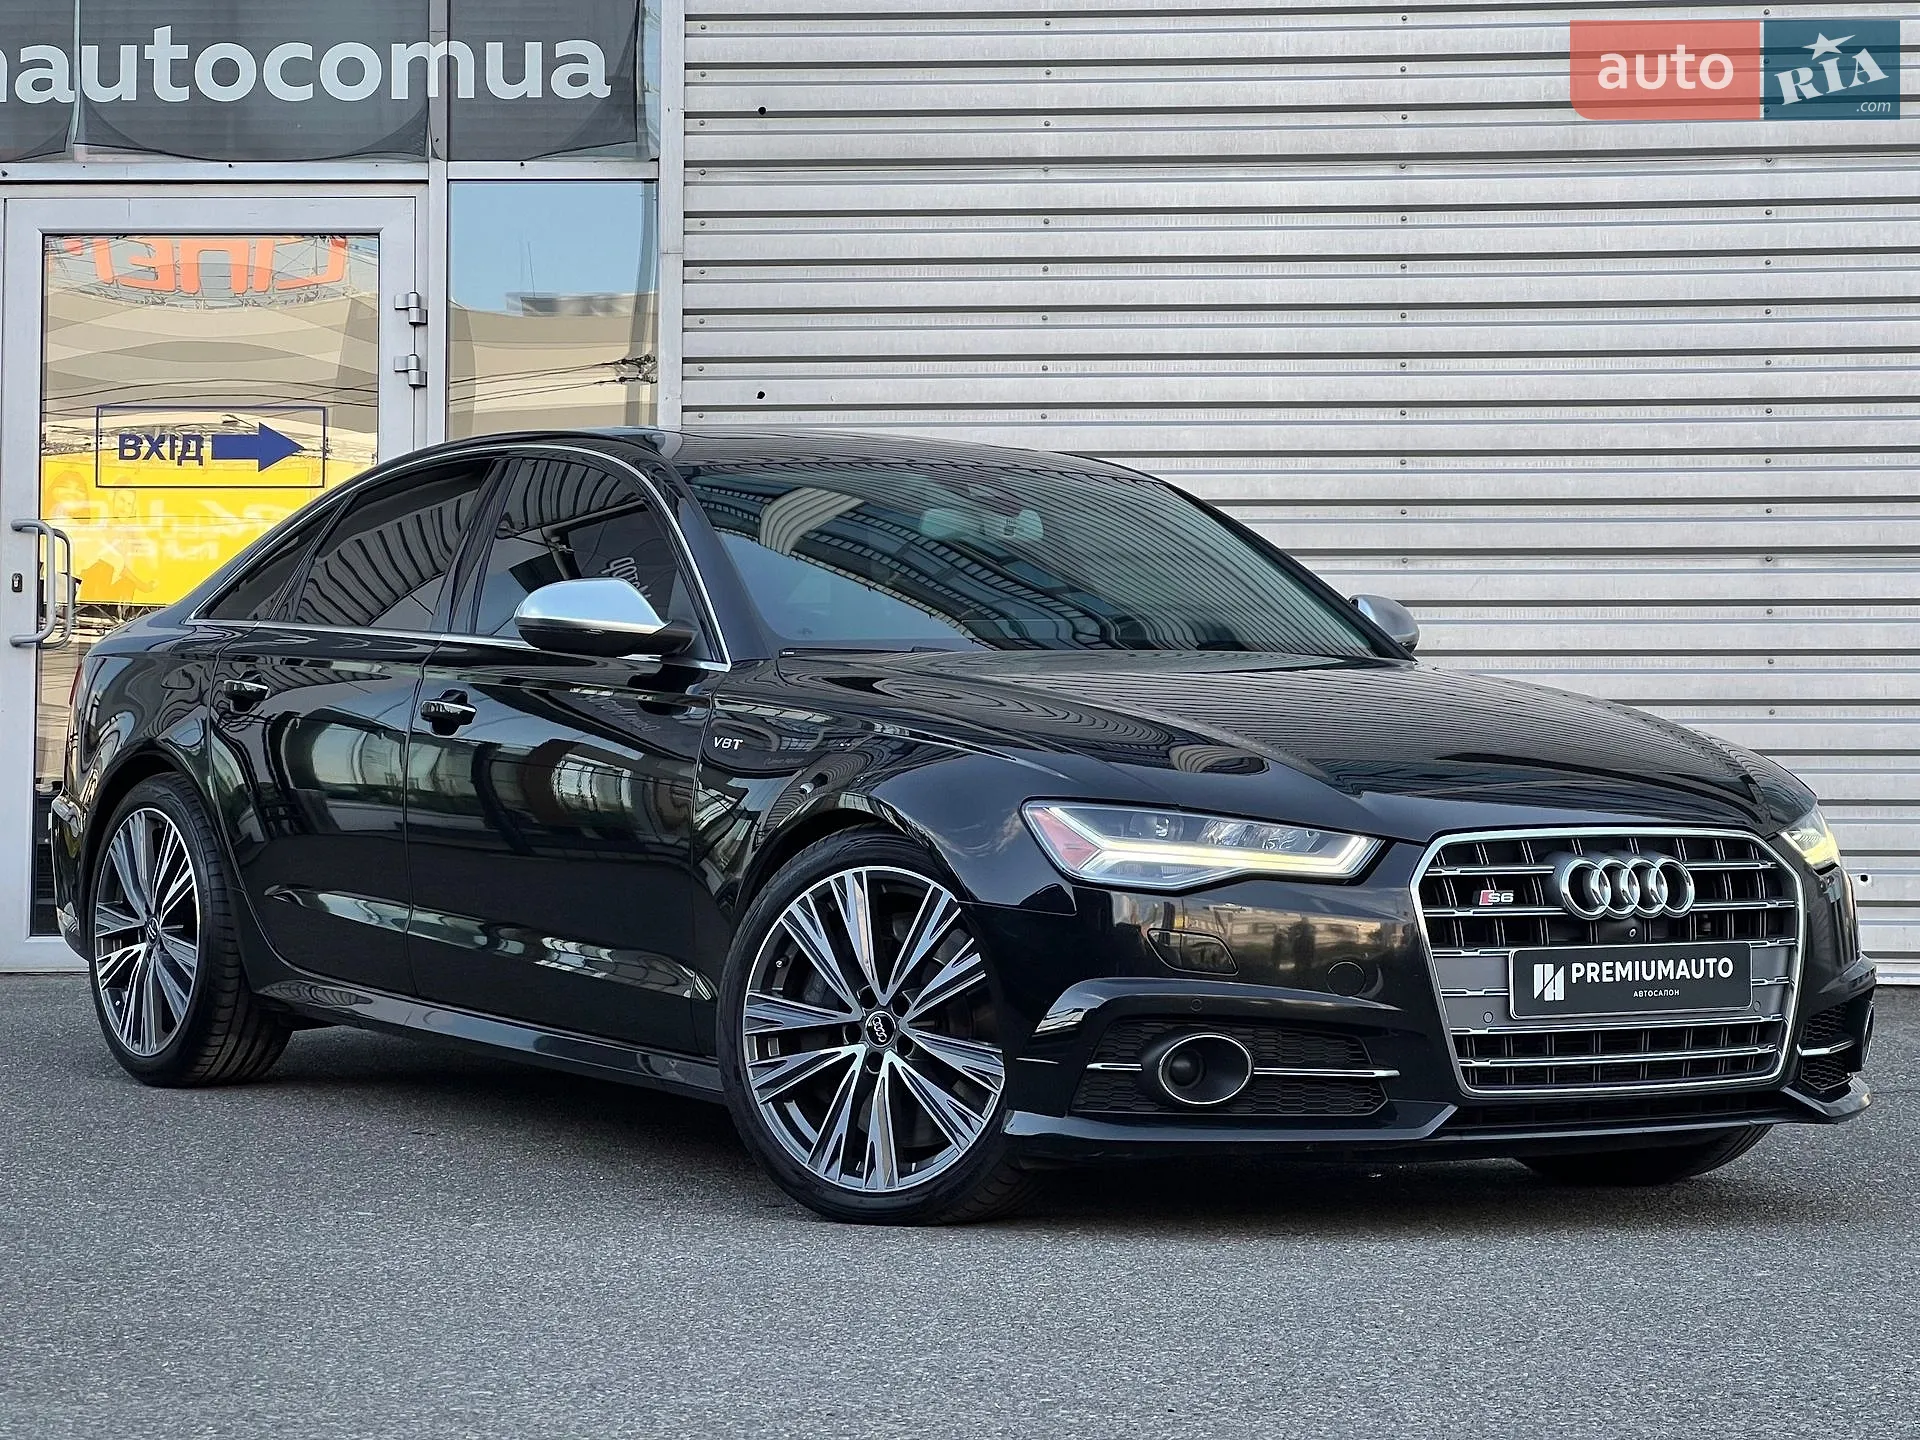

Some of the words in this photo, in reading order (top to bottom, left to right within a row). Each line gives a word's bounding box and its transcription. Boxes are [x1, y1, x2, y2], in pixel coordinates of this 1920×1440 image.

[0, 25, 612, 102] autocomua
[118, 433, 204, 466] ВХІД
[713, 736, 744, 751] V8T
[1486, 891, 1514, 903] S6
[1571, 957, 1734, 984] PREMIUMAUTO
[1633, 989, 1680, 998] АВТОСАЛОН
